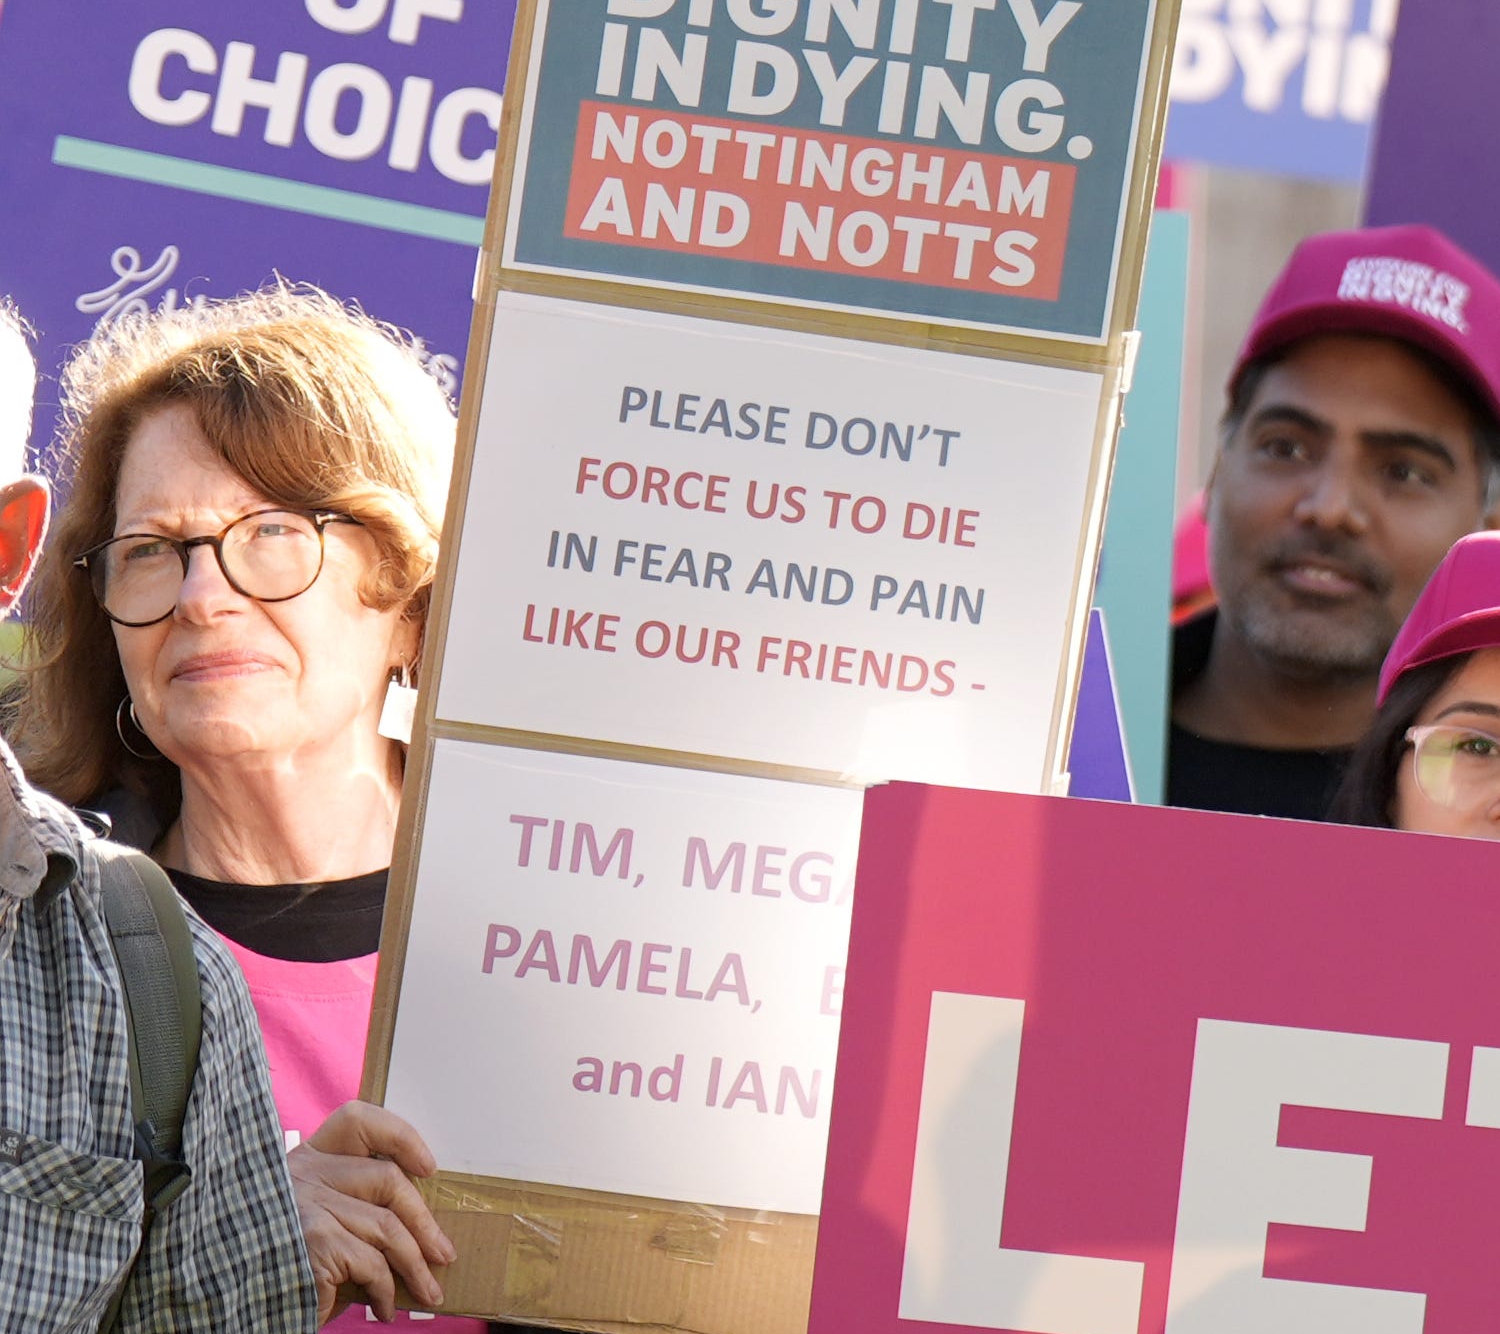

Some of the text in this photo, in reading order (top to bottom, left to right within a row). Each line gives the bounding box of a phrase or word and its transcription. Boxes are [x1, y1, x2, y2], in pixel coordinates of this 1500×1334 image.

[594, 21, 1095, 162] IN DYING.
[590, 110, 1051, 219] NOTTINGHAM
[579, 177, 1039, 288] AND NOTTS
[618, 385, 961, 468] PLEASE DON'T
[574, 456, 981, 548] FORCE US TO DIE
[546, 530, 987, 625] IN FEAR AND PAIN
[521, 603, 622, 653] LIKE
[633, 619, 742, 670] OUR
[756, 634, 958, 699] FRIENDS
[508, 813, 646, 889] TIM,
[480, 922, 764, 1015] PAMELA,
[571, 1053, 823, 1120] and IAN
